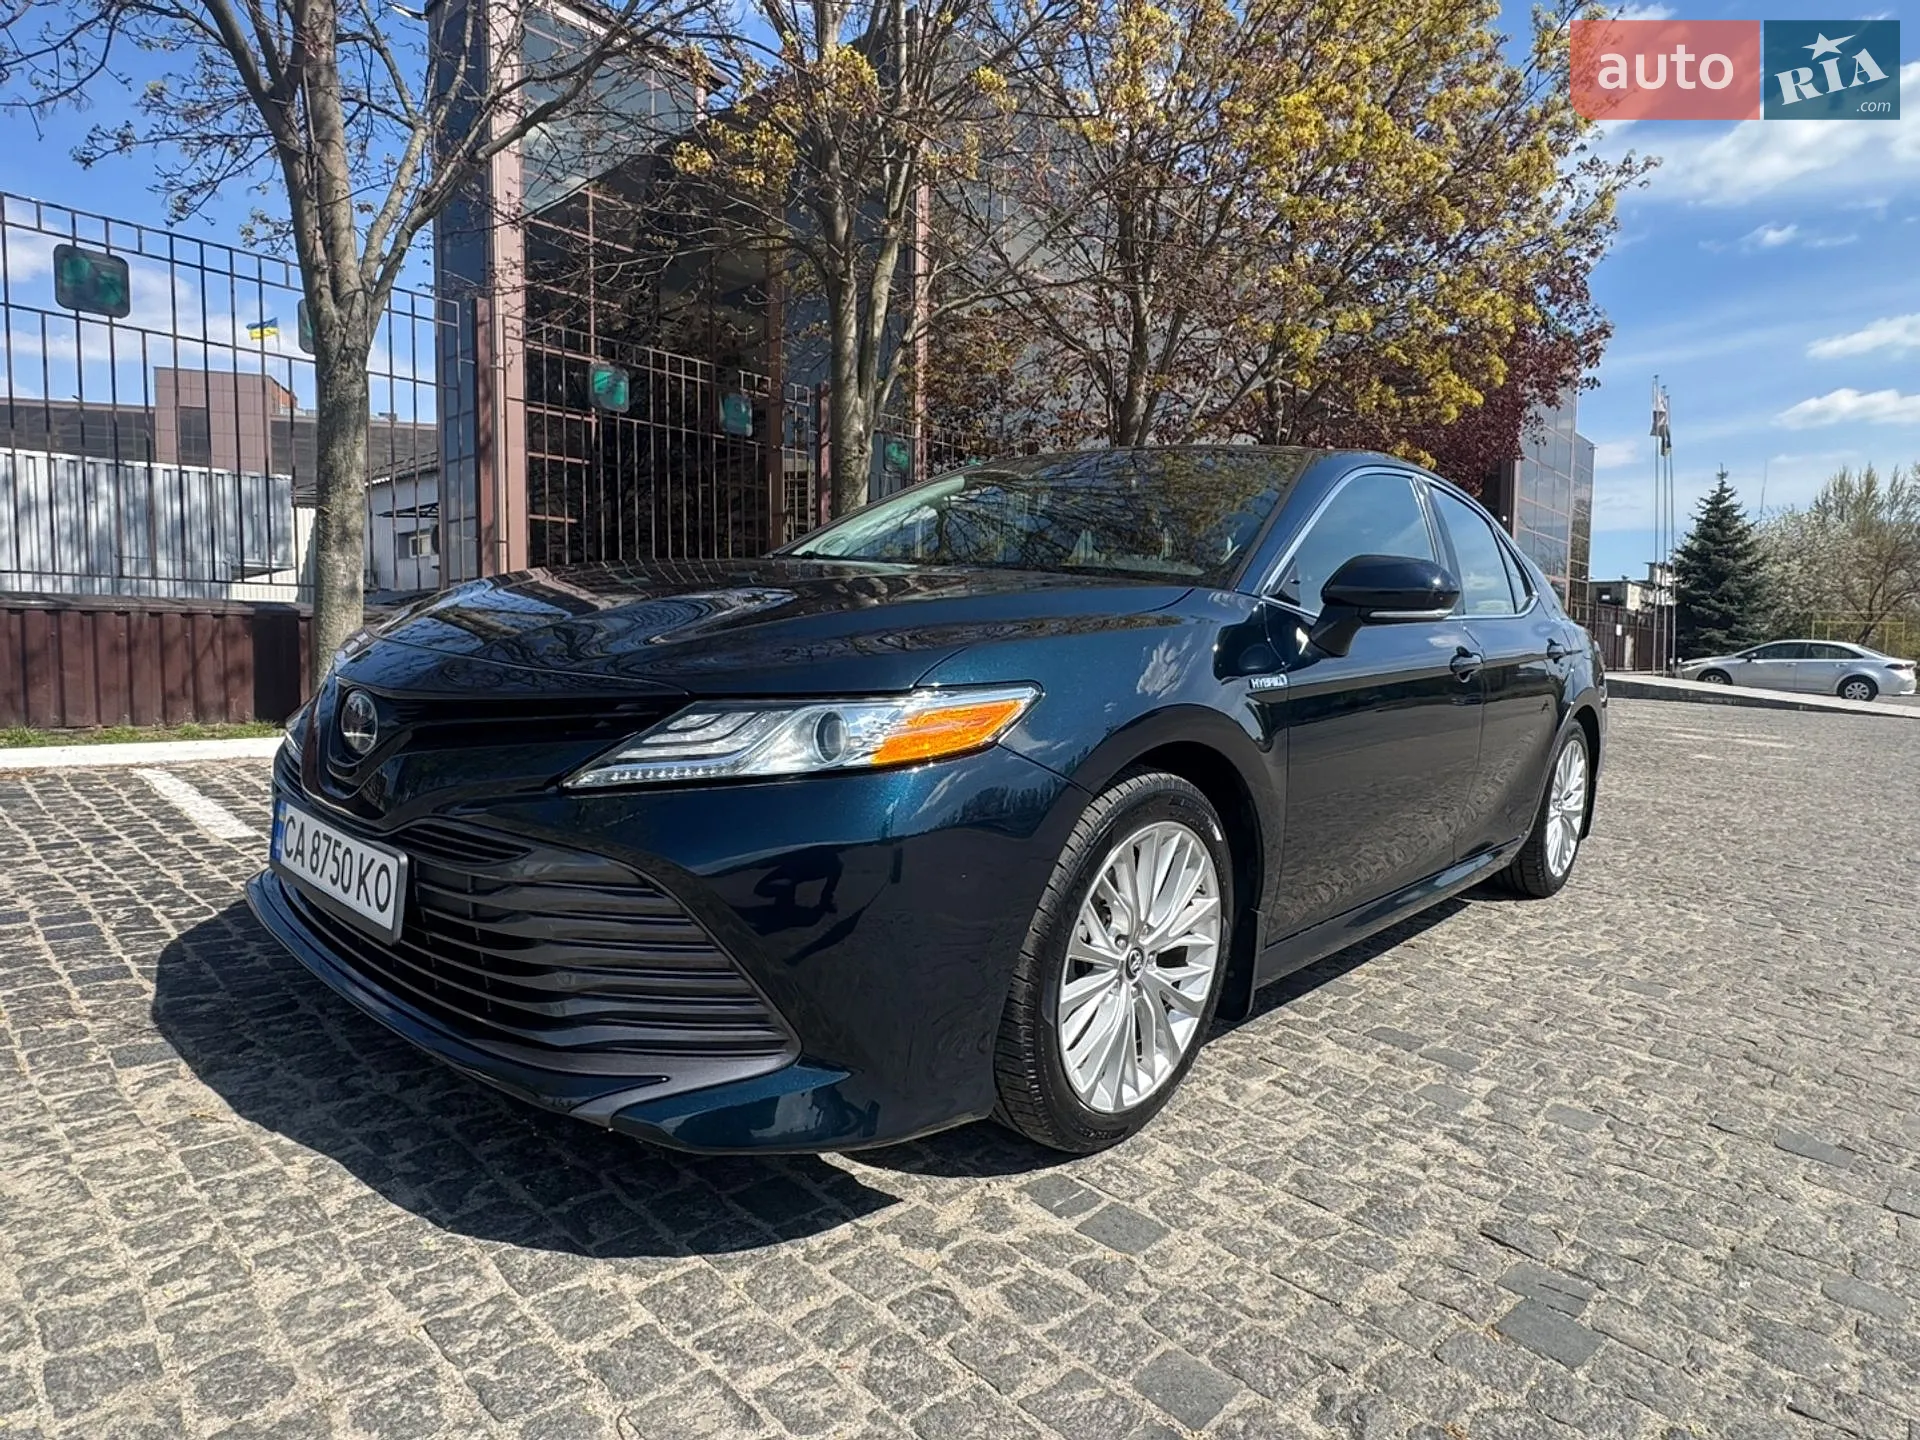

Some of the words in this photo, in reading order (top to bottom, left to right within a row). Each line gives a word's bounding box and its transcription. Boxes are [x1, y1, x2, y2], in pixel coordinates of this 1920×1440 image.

[1250, 674, 1288, 689] HYBRID
[284, 815, 305, 868] CA
[309, 829, 353, 894] 8750
[356, 852, 391, 913] KO
